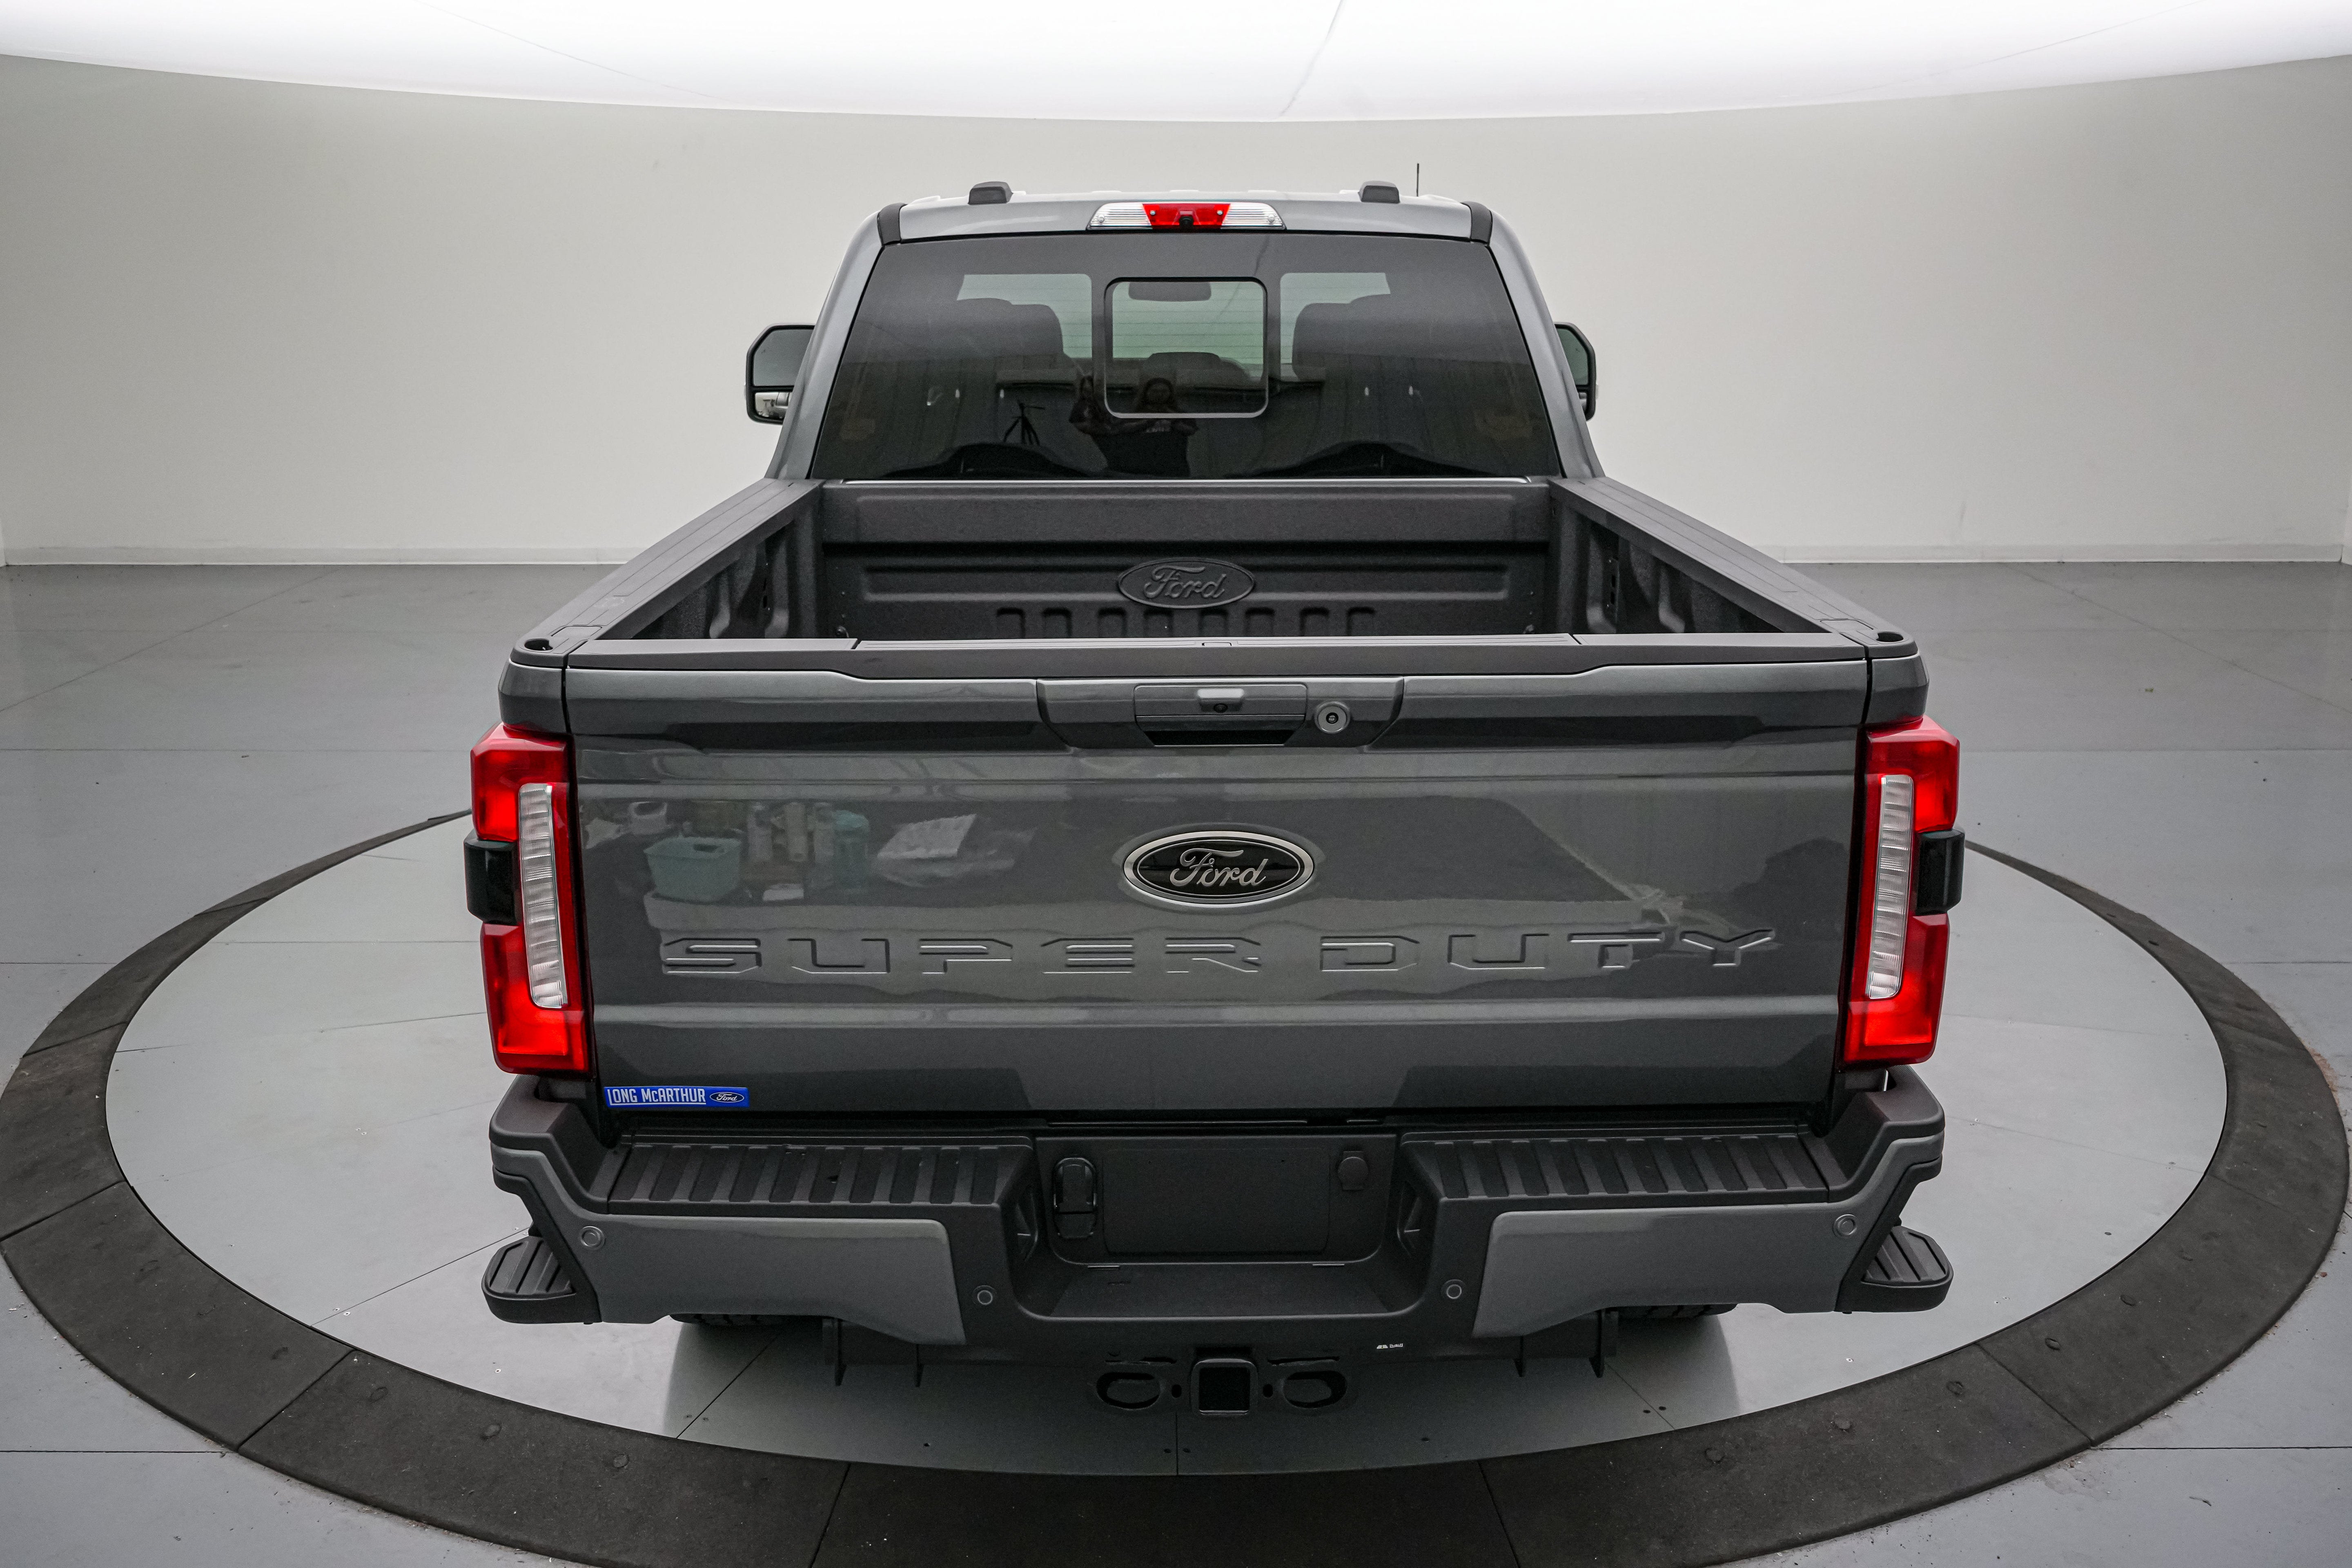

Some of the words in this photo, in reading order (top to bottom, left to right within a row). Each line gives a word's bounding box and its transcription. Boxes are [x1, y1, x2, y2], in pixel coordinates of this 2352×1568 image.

[1144, 564, 1227, 599] Ford
[1169, 848, 1269, 887] Ford
[660, 937, 1261, 974] SUPER
[1319, 929, 1776, 972] DUTY
[607, 1089, 638, 1105] LONG
[641, 1088, 706, 1102] McARTHUR
[716, 1093, 737, 1101] Ford
